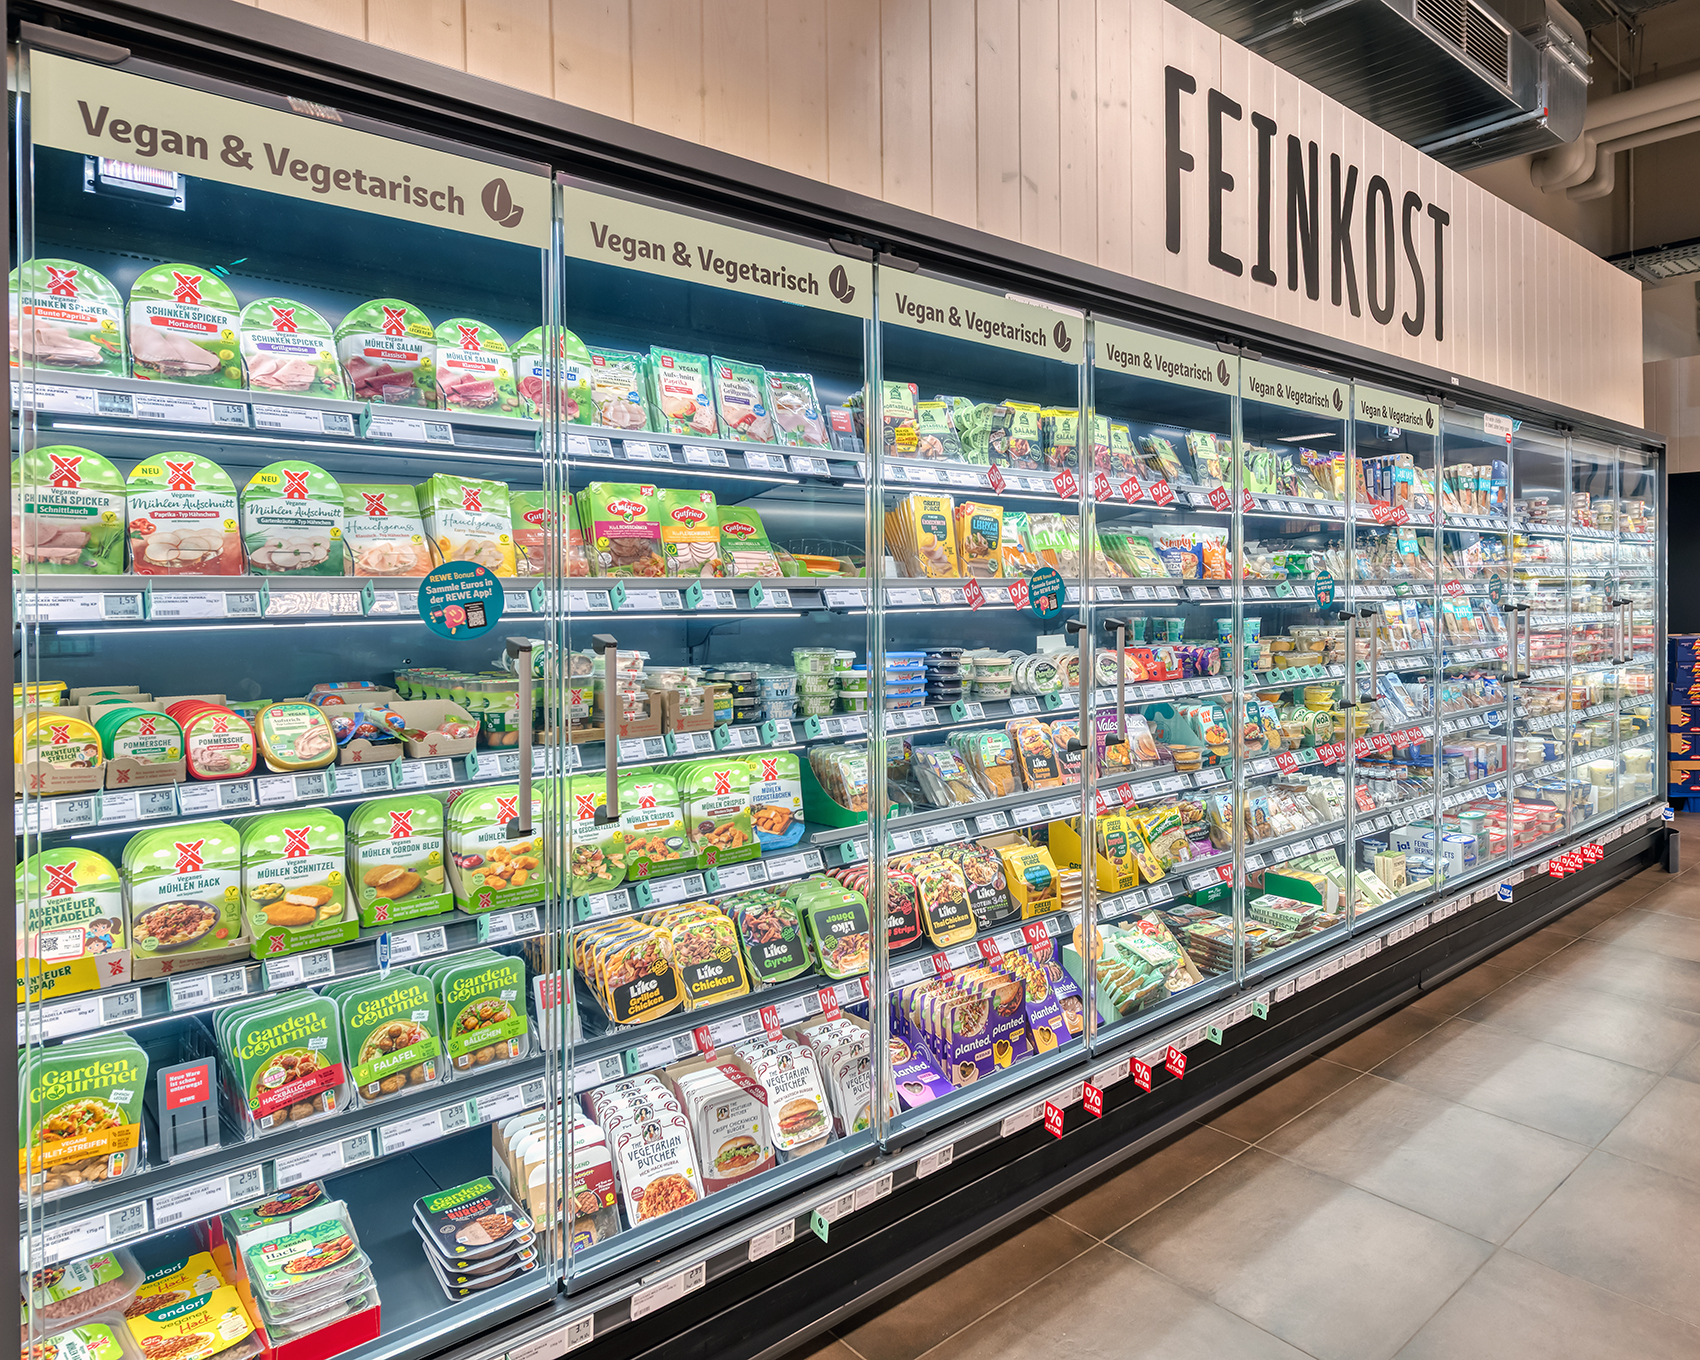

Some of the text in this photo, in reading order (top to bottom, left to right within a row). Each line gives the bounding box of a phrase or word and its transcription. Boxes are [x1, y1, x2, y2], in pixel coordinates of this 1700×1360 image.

[77, 100, 465, 216] Vegan & Vegetarisch
[1165, 65, 1450, 342] FEINKOST
[590, 221, 819, 296] Vegan & Vegetarisch
[37, 308, 92, 322] Bunte Paprika
[146, 305, 228, 325] SCHINKEN SPICKER
[175, 302, 200, 312] Veganer
[168, 319, 207, 331] Mortadella
[895, 292, 1046, 347] Vegan & Vegetarisch
[251, 334, 324, 348] SCHINKEN SPICKER
[364, 338, 423, 353] MÜHLEN SALAMI
[381, 351, 407, 360] Klassisch
[446, 352, 499, 365] MÜHLEN SALAMI
[1106, 343, 1213, 383] Vegan & Vegetarisch
[678, 365, 699, 373] VEGAN
[1249, 376, 1330, 409] Vegan & Vegetarisch
[1360, 400, 1424, 427] Vegan & Vegetarisch
[261, 475, 278, 483] NEU
[51, 488, 79, 496] Veganer
[39, 505, 89, 515] Schnittlauch
[129, 498, 235, 511] Mühlen Aufschnitt
[250, 504, 342, 518] Mühlen Aufschnitt
[673, 508, 705, 520] Gutfried
[724, 524, 752, 533] Gutfried
[430, 572, 475, 582] REWE Bonus
[425, 578, 493, 595] Sammle Euros in
[430, 588, 493, 604] der REWE App!
[123, 739, 172, 749] POMMERSCHE
[198, 736, 244, 746] POMMERSCHE
[40, 746, 81, 758] ABENTEUER
[47, 753, 77, 763] STREICH
[752, 791, 792, 802] FISCHSTÄBCHEN
[761, 786, 781, 794] MÜHLEN
[701, 797, 746, 811] MÜHLEN CRISPIES
[626, 811, 675, 824] MÜHLEN CRISPIES
[478, 832, 506, 842] MÜHLEN
[362, 840, 440, 859] MÜHLEN CORDON BLEU
[1397, 841, 1411, 852] ja!
[257, 861, 335, 879] MÜHLEN SCHNITZEL
[286, 858, 307, 866] Vegane
[158, 877, 220, 895] MÜHLEN HACK
[177, 874, 202, 882] Veganes
[46, 897, 71, 905] Vegane
[976, 888, 996, 899] Like
[826, 911, 855, 923] Döner
[938, 905, 957, 918] Like
[831, 920, 855, 934] Like
[894, 925, 915, 936] Strips
[764, 944, 788, 958] Like
[764, 954, 793, 969] Gyros
[452, 966, 511, 992] Garden
[696, 964, 723, 980] Like
[447, 972, 519, 1004] Gourmet
[629, 978, 658, 998] Like
[692, 974, 735, 993] Chicken
[357, 985, 420, 1014] Garden
[628, 995, 664, 1016] Chicken
[629, 989, 660, 1007] Grilled
[350, 992, 429, 1029] Gourmet
[1030, 1002, 1059, 1024] planted.
[247, 1012, 317, 1045] Garden
[241, 1016, 329, 1060] Gourmet
[463, 1028, 502, 1047] BÄLLCHEN
[955, 1035, 991, 1059] planted.
[373, 1050, 416, 1072] FALAFEL
[42, 1059, 128, 1087] Garden
[169, 1070, 201, 1082] Neue Ware
[179, 1077, 196, 1085] schon
[766, 1066, 810, 1088] VEGETARIAN
[29, 1066, 139, 1104] Gourmet
[170, 1080, 203, 1093] unterwegs!
[262, 1078, 317, 1105] HACKBÄLLCHEN
[775, 1076, 808, 1094] BUTCHER
[179, 1095, 195, 1103] REWE
[61, 1137, 87, 1146] VEGANE
[628, 1135, 682, 1162] VEGETARIAN
[37, 1138, 108, 1162] FILET-STREIFEN
[637, 1149, 676, 1169] BUTCHER
[433, 1184, 484, 1205] Garden
[447, 1200, 493, 1220] BURGER
[146, 1262, 183, 1281] ndori
[141, 1272, 185, 1291] veganes
[159, 1275, 194, 1293] Hack
[158, 1297, 205, 1321] endori
[161, 1310, 208, 1329] veganes
[179, 1314, 216, 1335] Hack
